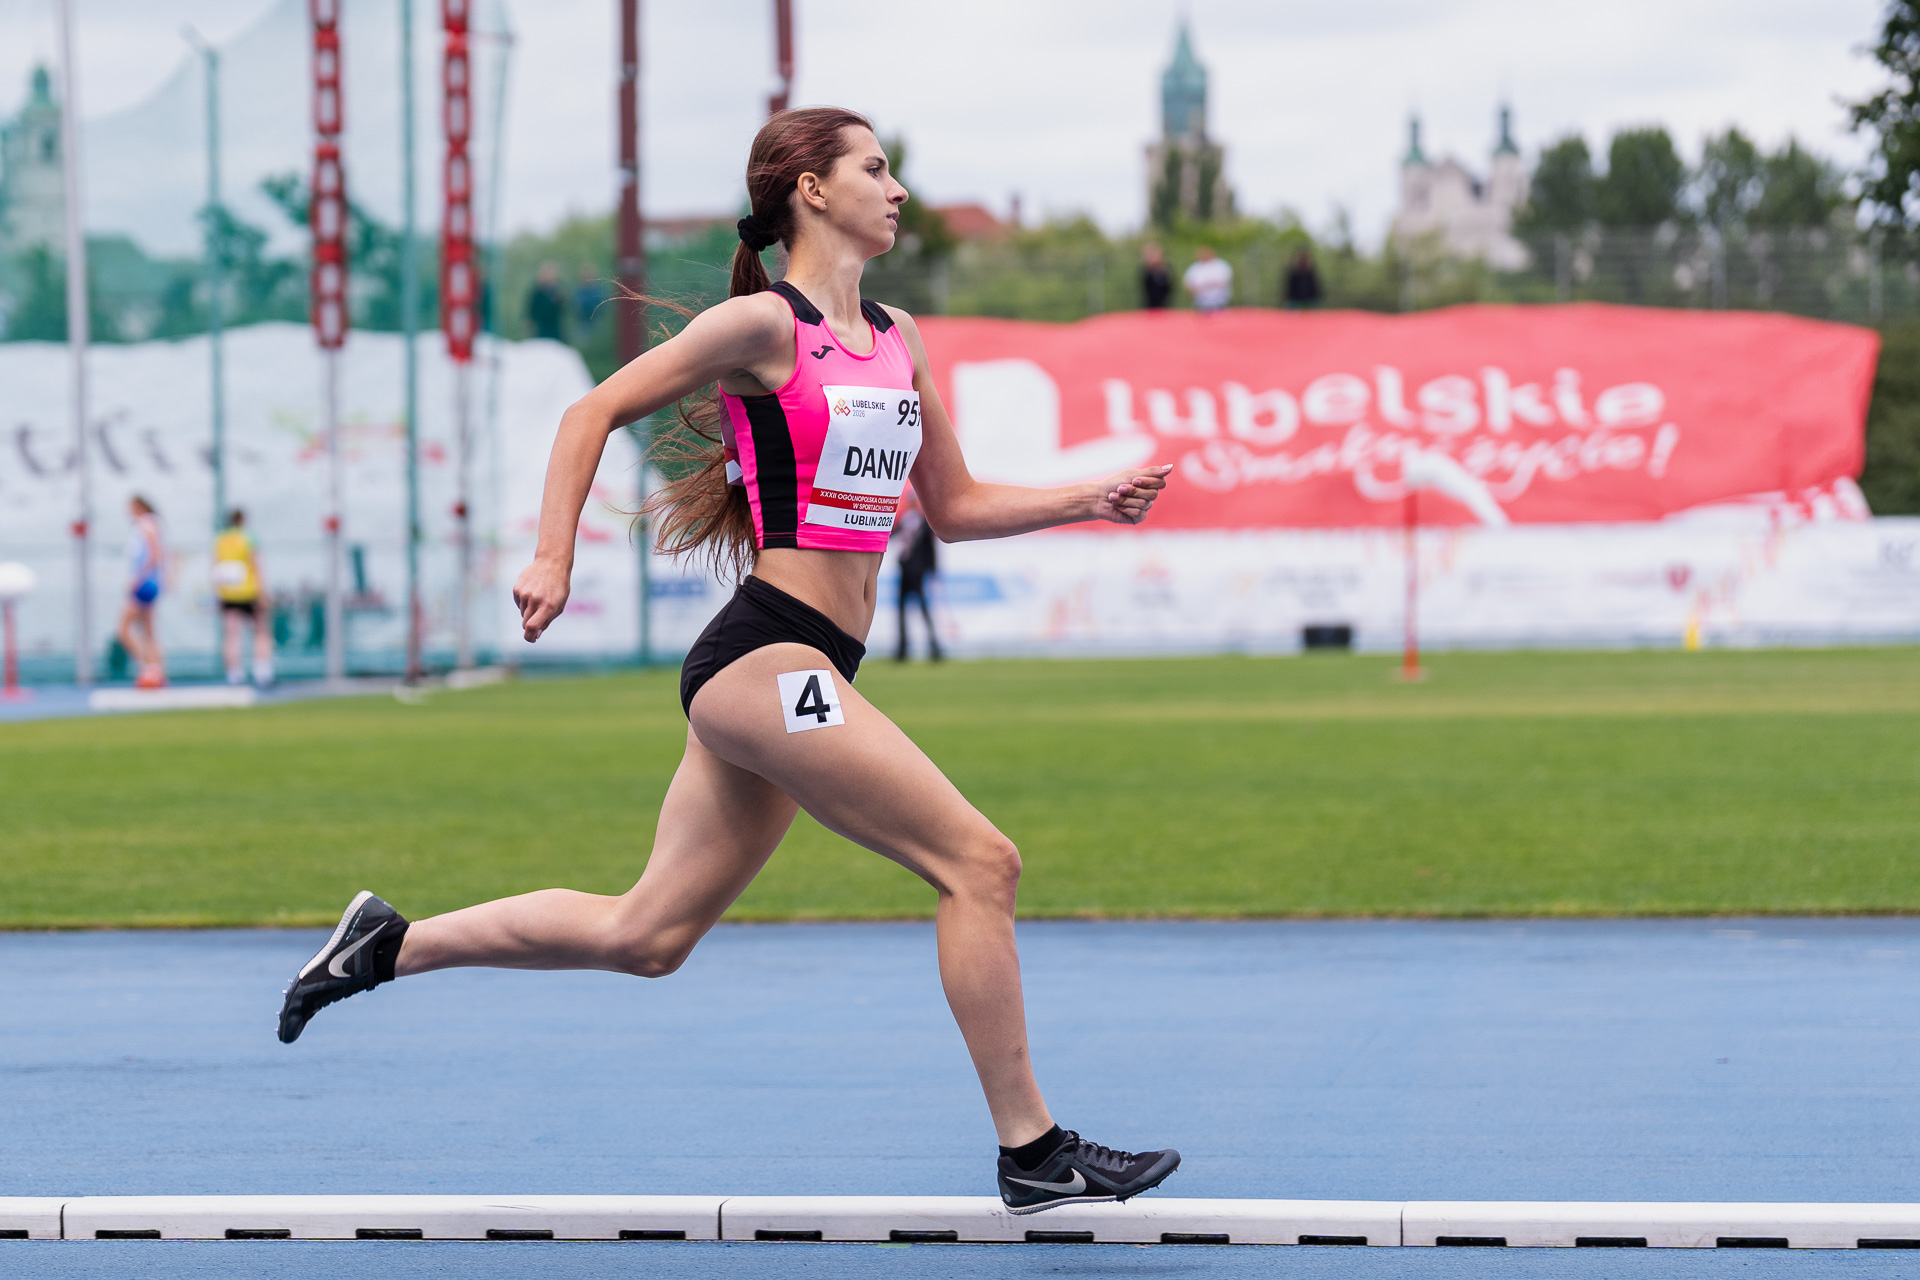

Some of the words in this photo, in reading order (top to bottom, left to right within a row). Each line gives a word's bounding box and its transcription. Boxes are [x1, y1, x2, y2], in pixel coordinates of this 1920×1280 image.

[852, 399, 886, 411] LUBELSKIE
[852, 409, 866, 418] 2026
[820, 490, 837, 499] XXXII
[844, 514, 878, 527] LUBLIN
[795, 674, 831, 724] 4
